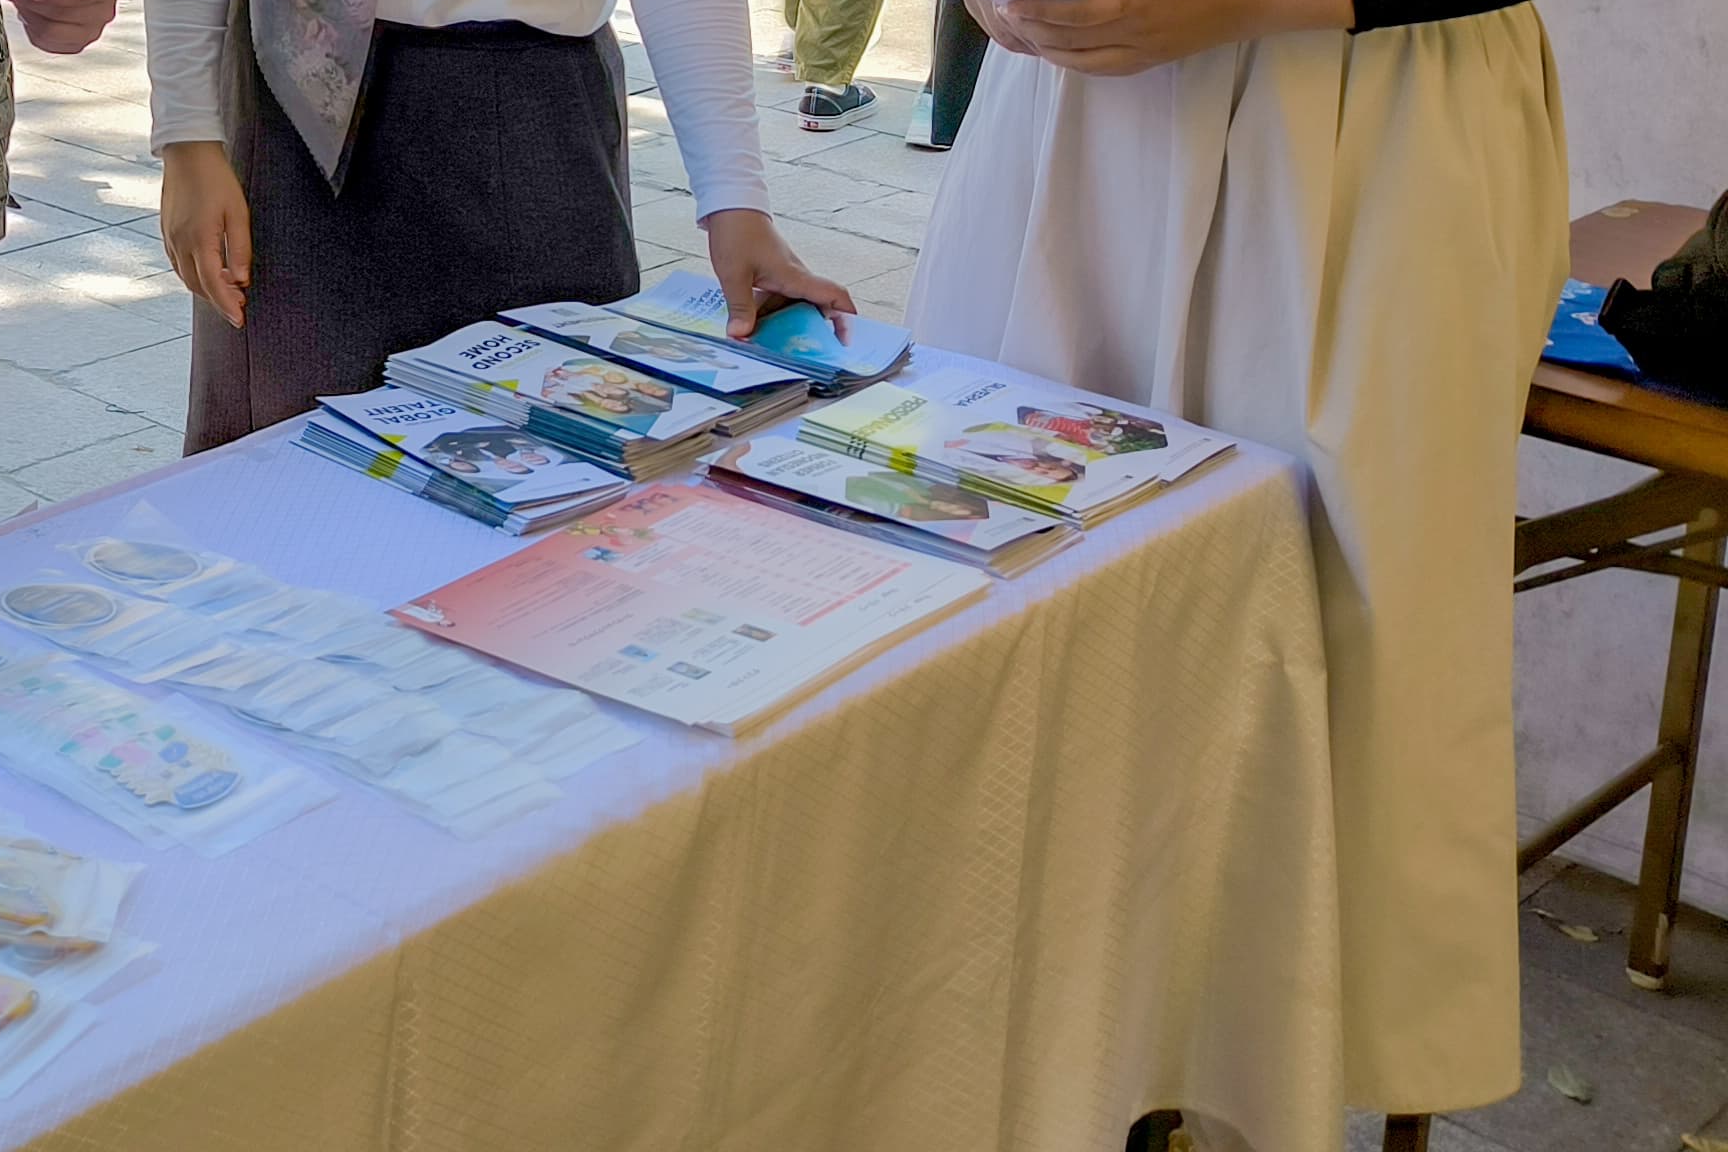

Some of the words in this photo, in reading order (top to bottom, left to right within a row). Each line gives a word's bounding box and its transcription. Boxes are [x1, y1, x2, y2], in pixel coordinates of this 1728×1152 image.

[459, 334, 512, 360] HOME
[471, 338, 542, 370] SECOND
[363, 398, 444, 417] TALENT
[373, 406, 456, 426] GLOBAL
